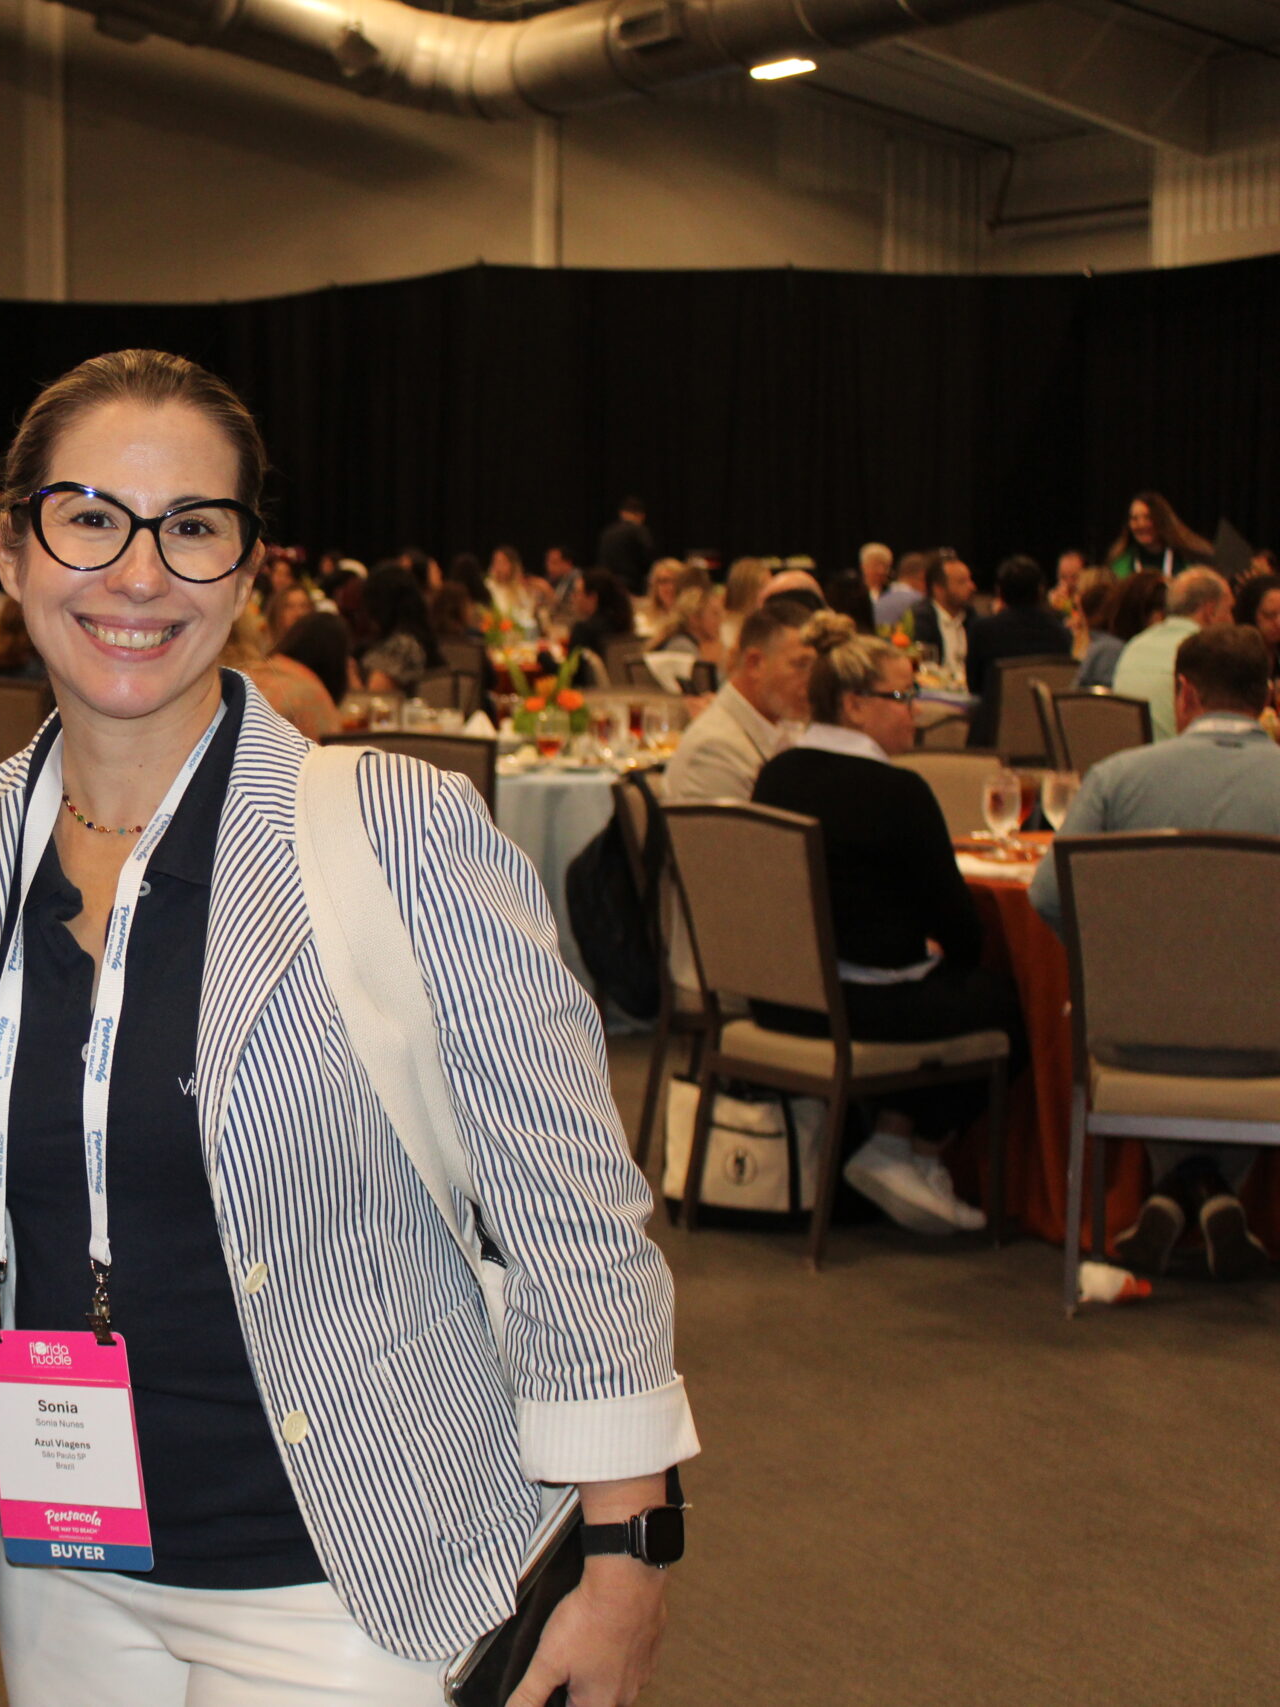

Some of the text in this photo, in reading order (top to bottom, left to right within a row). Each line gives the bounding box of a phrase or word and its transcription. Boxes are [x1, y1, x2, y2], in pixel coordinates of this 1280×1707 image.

[111, 905, 130, 970] Pensacola
[95, 1016, 114, 1083] Pensacola
[92, 1128, 104, 1195] Pensacola
[31, 1353, 72, 1366] huddle
[37, 1399, 78, 1414] Sonia
[35, 1417, 58, 1428] Sonia
[34, 1437, 91, 1450] Azul Viagens
[55, 1461, 75, 1471] Brazil
[44, 1509, 102, 1527] Pensacola
[51, 1543, 106, 1561] BUYER
